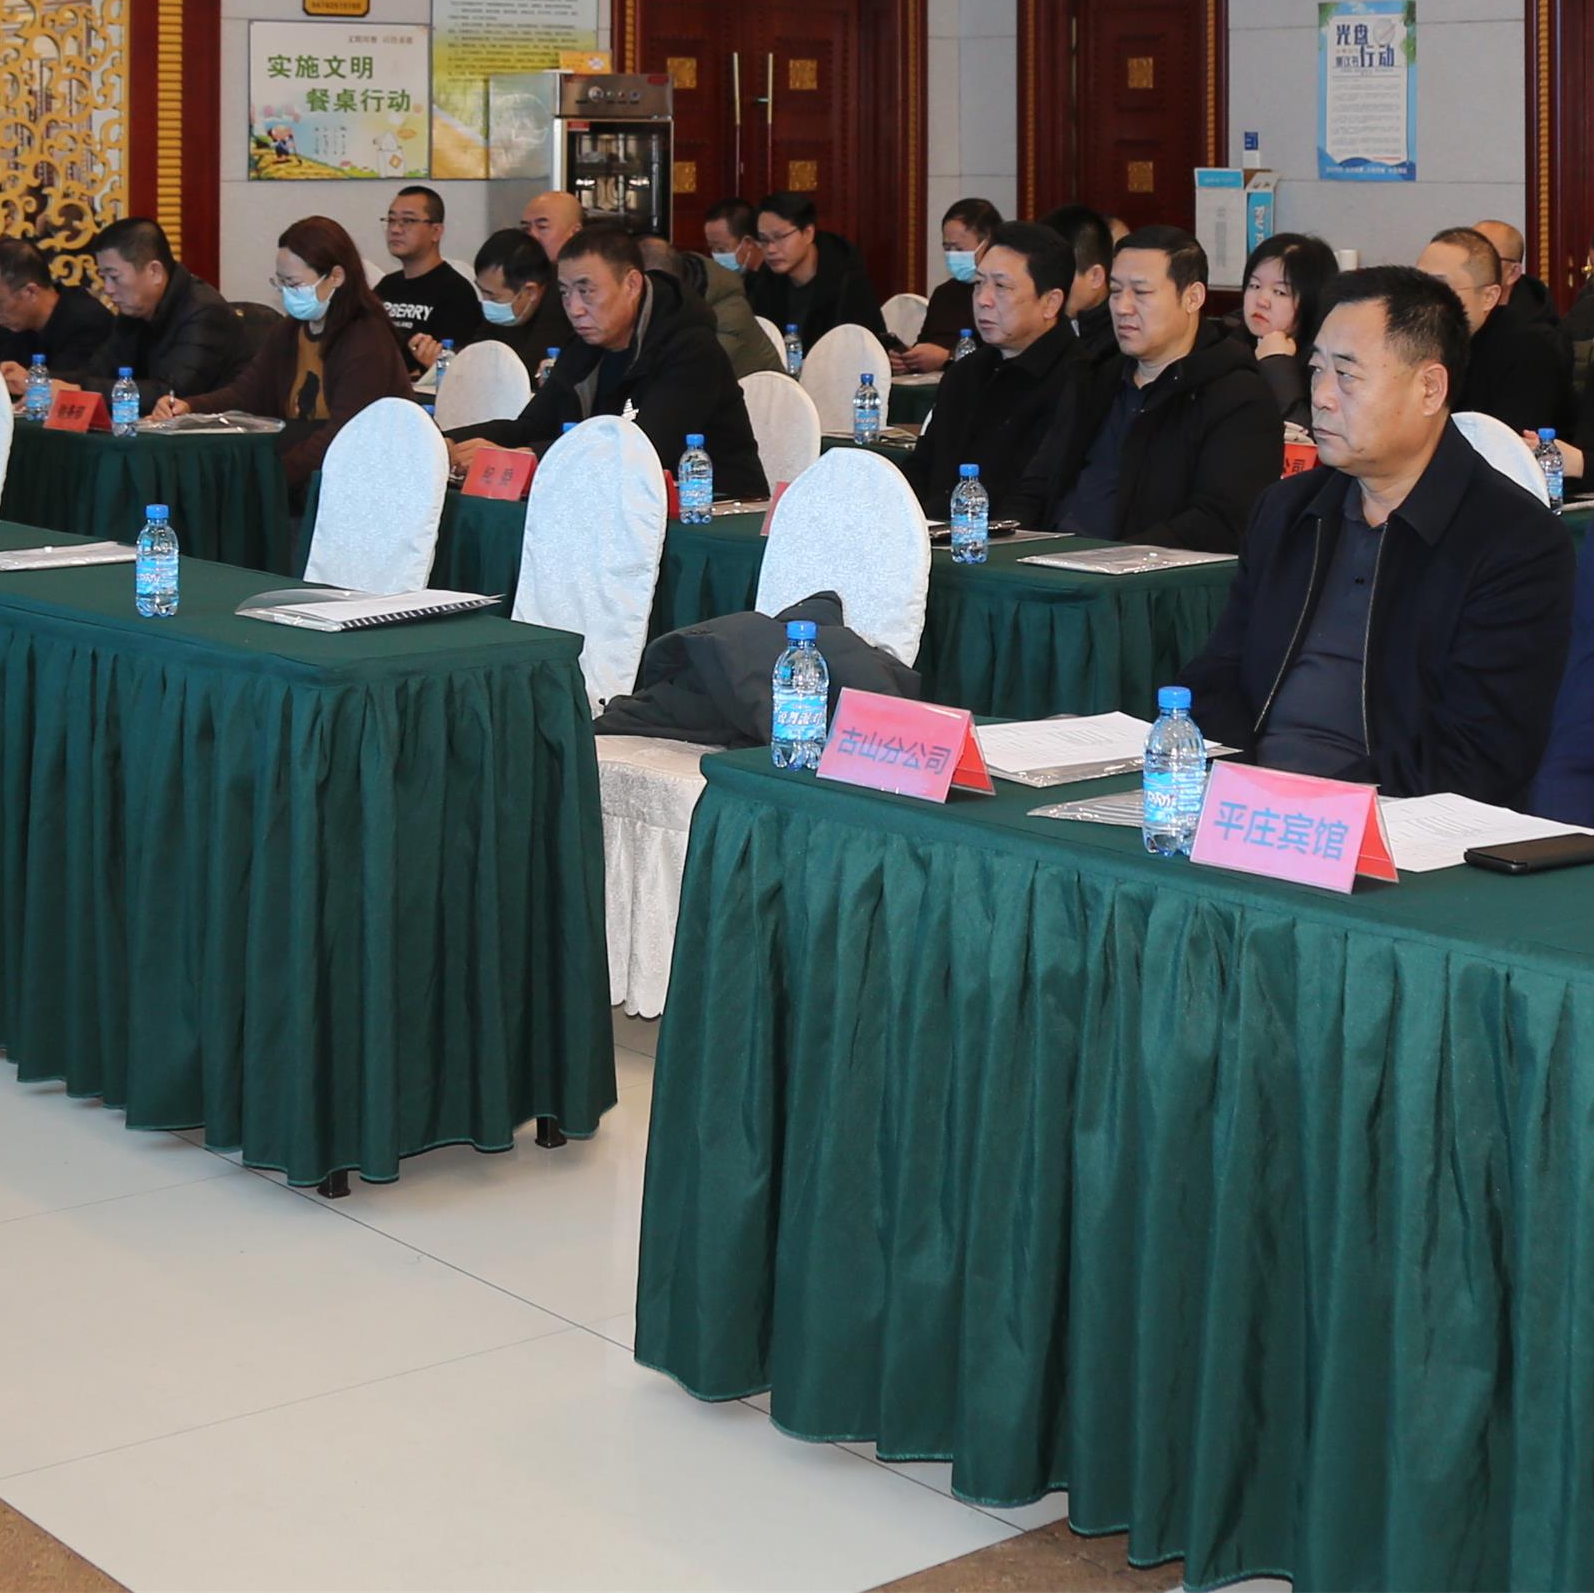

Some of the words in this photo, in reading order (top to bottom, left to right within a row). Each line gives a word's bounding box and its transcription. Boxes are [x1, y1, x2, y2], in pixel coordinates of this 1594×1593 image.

[1336, 23, 1369, 46] 光盘
[267, 54, 374, 80] 实施文明
[1360, 44, 1396, 68] 行动
[306, 88, 412, 113] 餐桌行动
[837, 727, 952, 776] 古山分公司
[1213, 801, 1350, 862] 平庄宾馆
